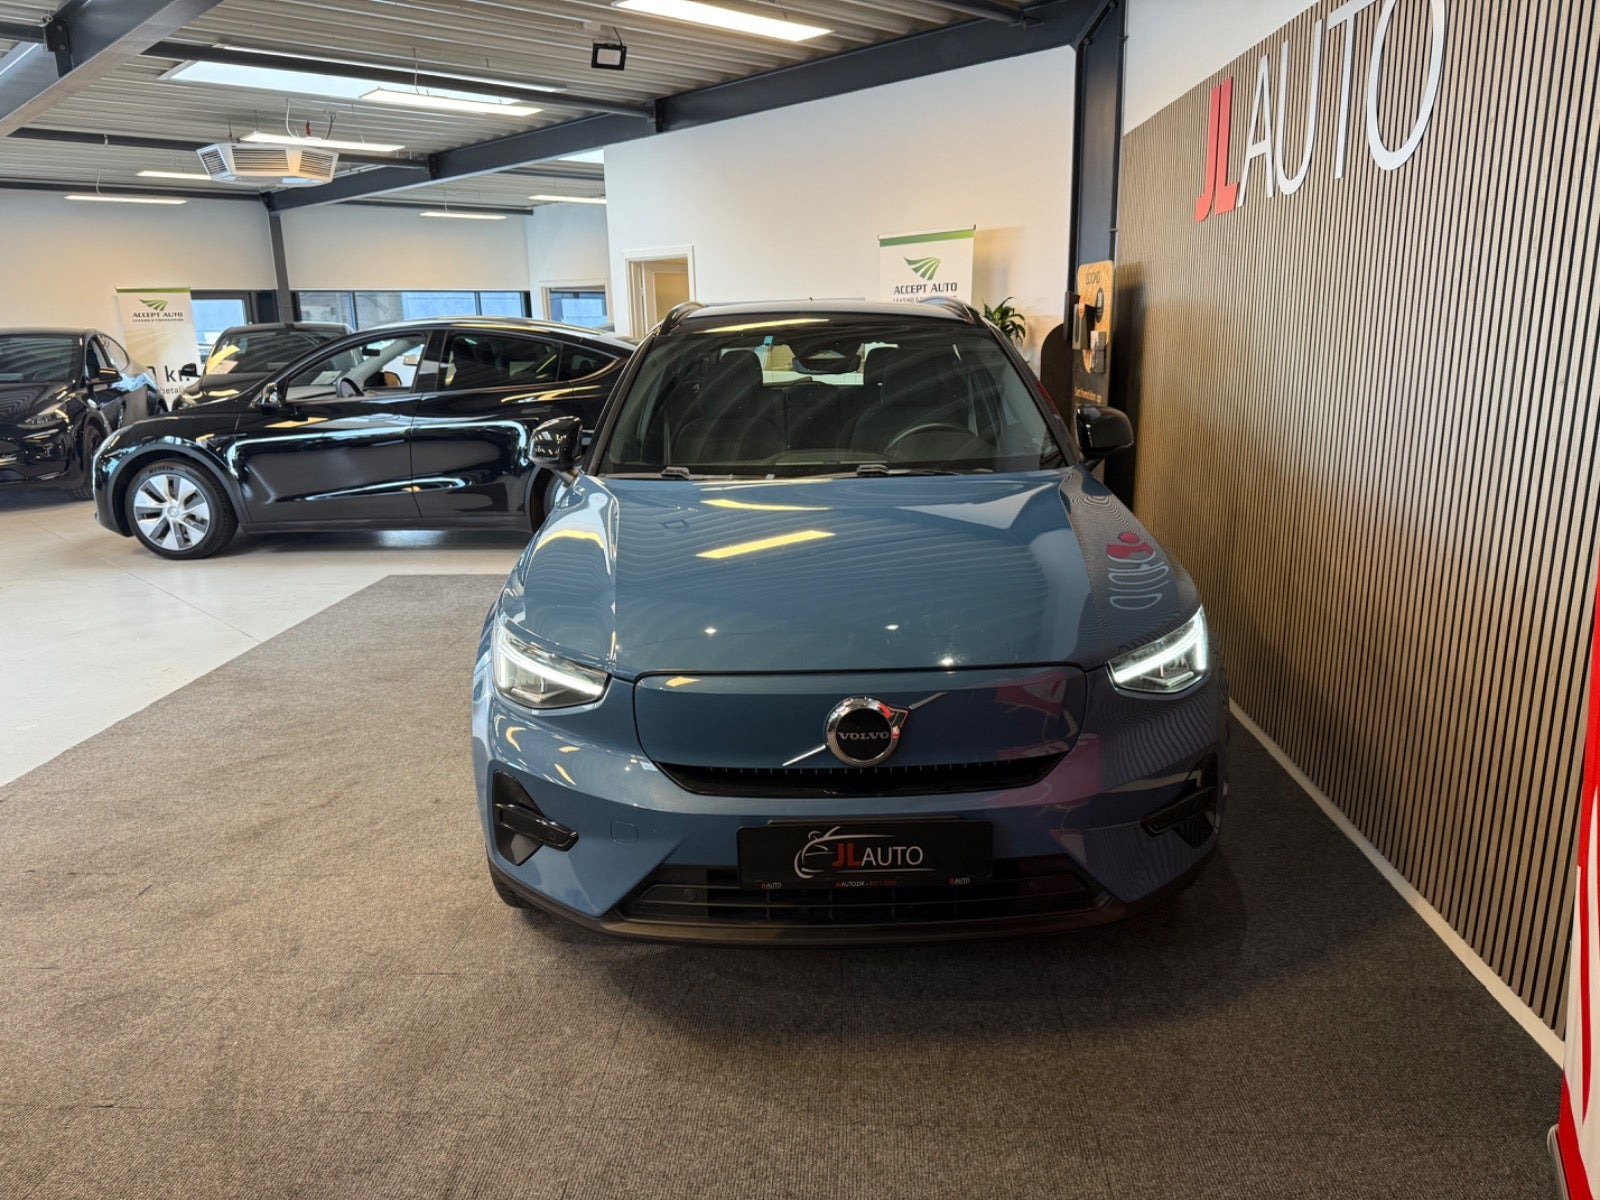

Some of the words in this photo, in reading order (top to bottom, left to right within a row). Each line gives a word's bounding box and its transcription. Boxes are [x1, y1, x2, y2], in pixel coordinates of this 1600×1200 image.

[893, 284, 927, 295] ACCEPT
[931, 282, 958, 293] AUTO
[838, 731, 889, 740] VOLVO
